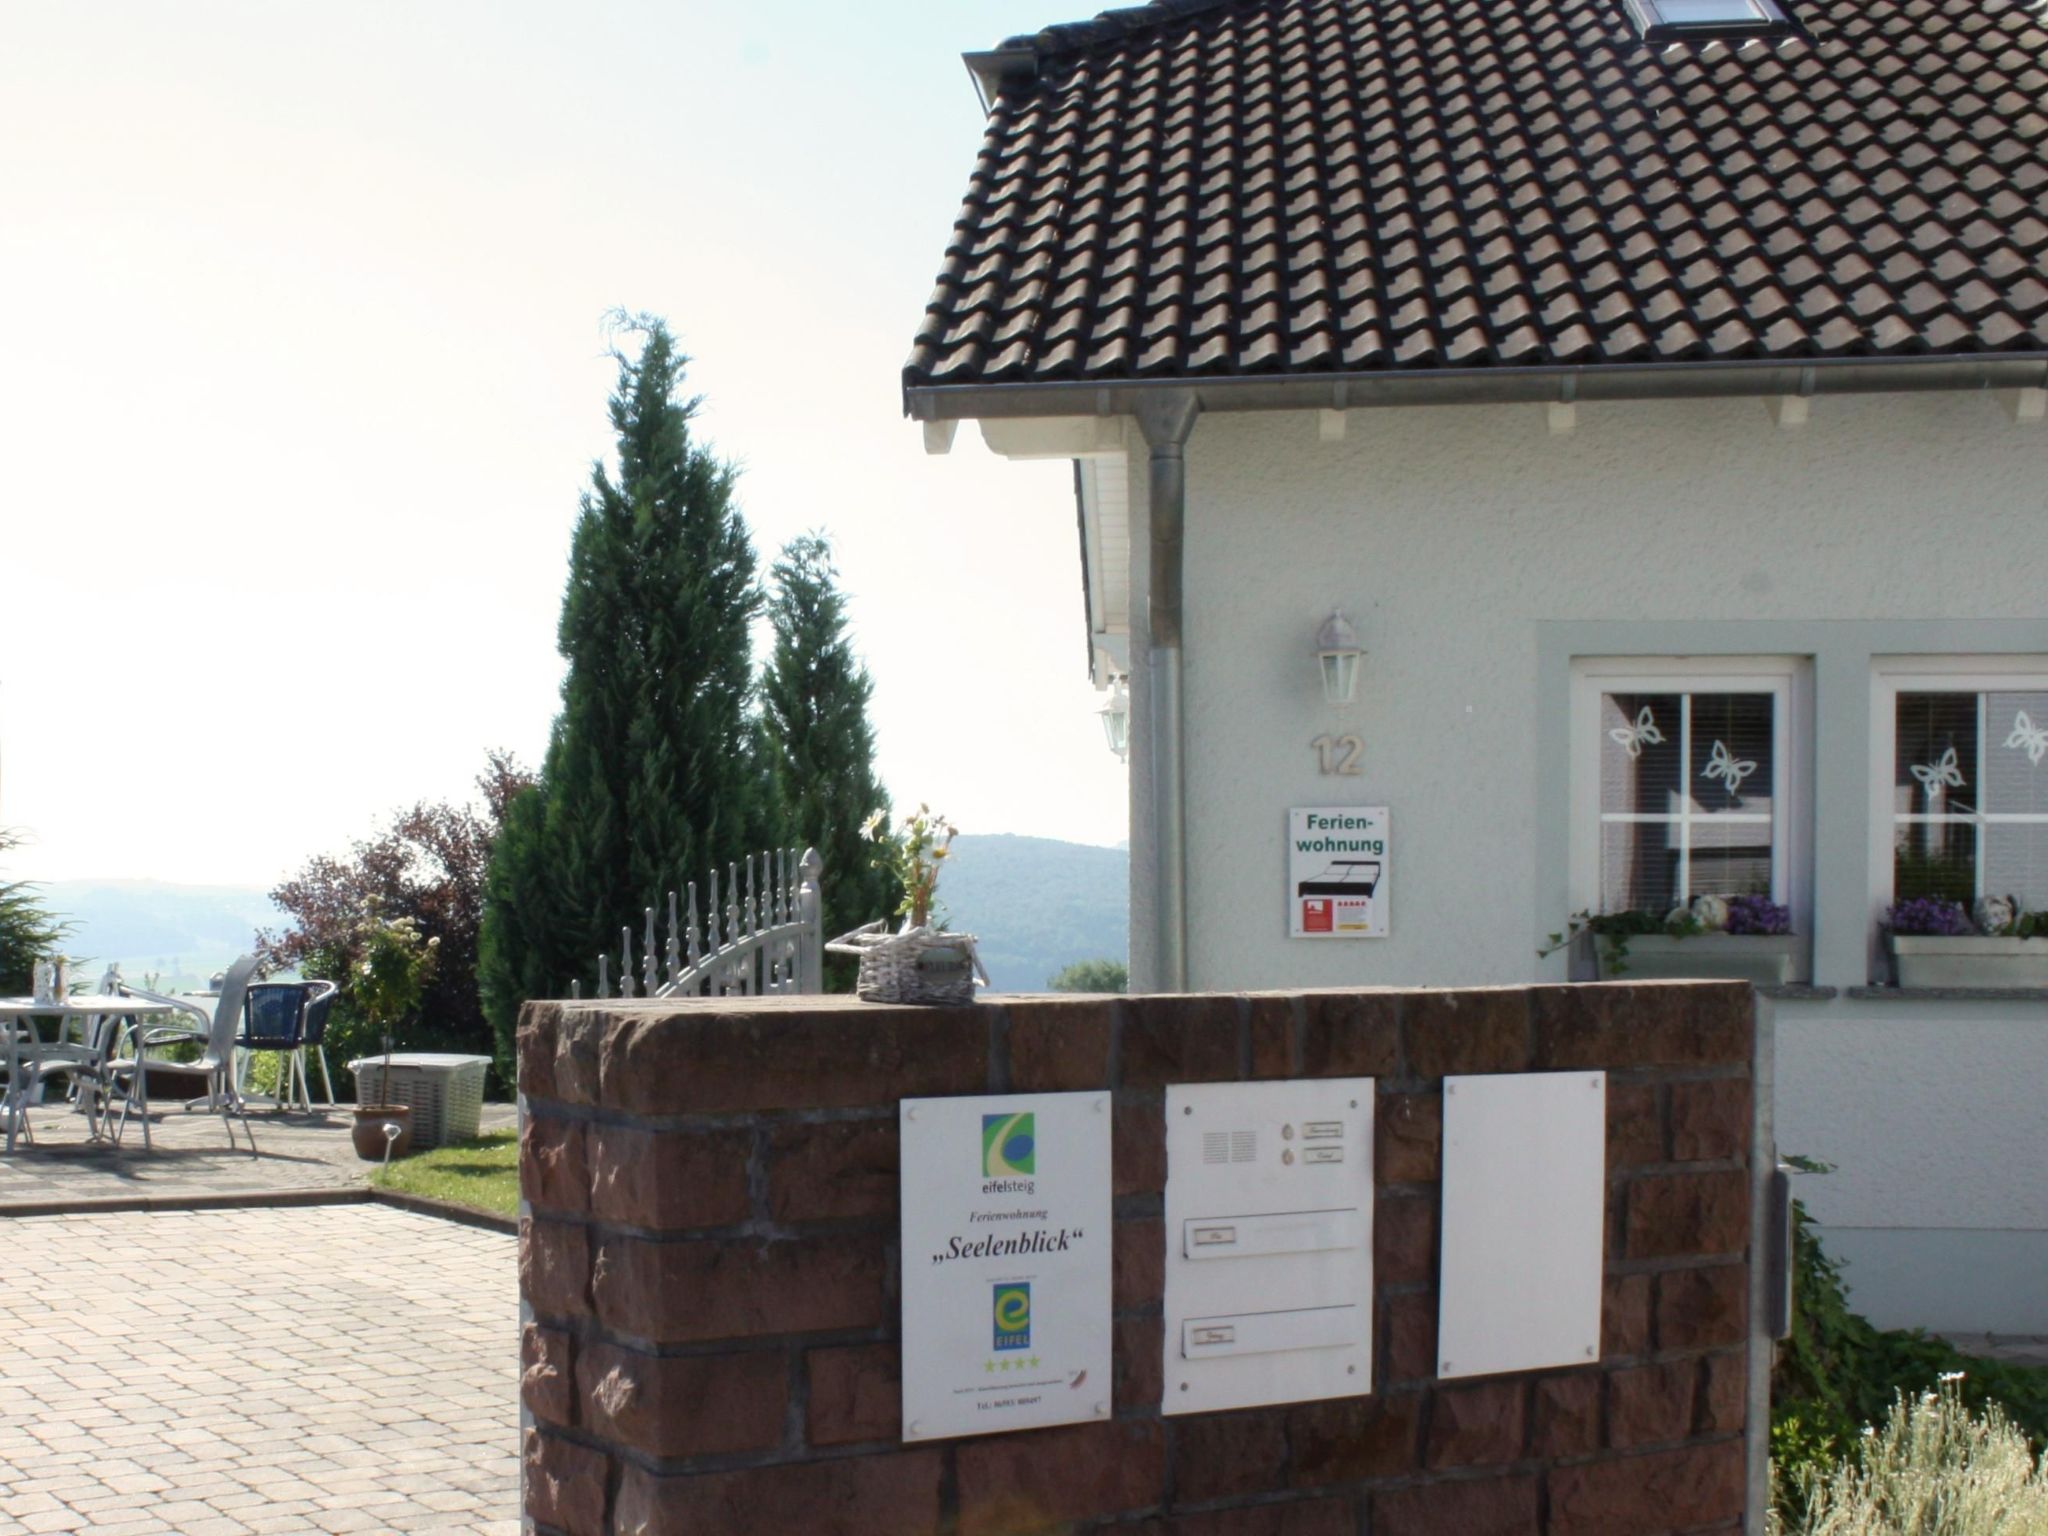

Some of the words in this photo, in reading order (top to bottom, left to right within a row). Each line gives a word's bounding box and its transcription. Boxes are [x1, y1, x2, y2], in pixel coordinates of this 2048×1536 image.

[1310, 735, 1365, 776] 12
[1307, 814, 1374, 830] Ferien-
[1296, 837, 1384, 855] wohnung
[982, 1180, 1035, 1195] eifelsteig
[969, 1208, 1048, 1224] Ferienwohnung
[996, 1335, 1030, 1347] EIFEL
